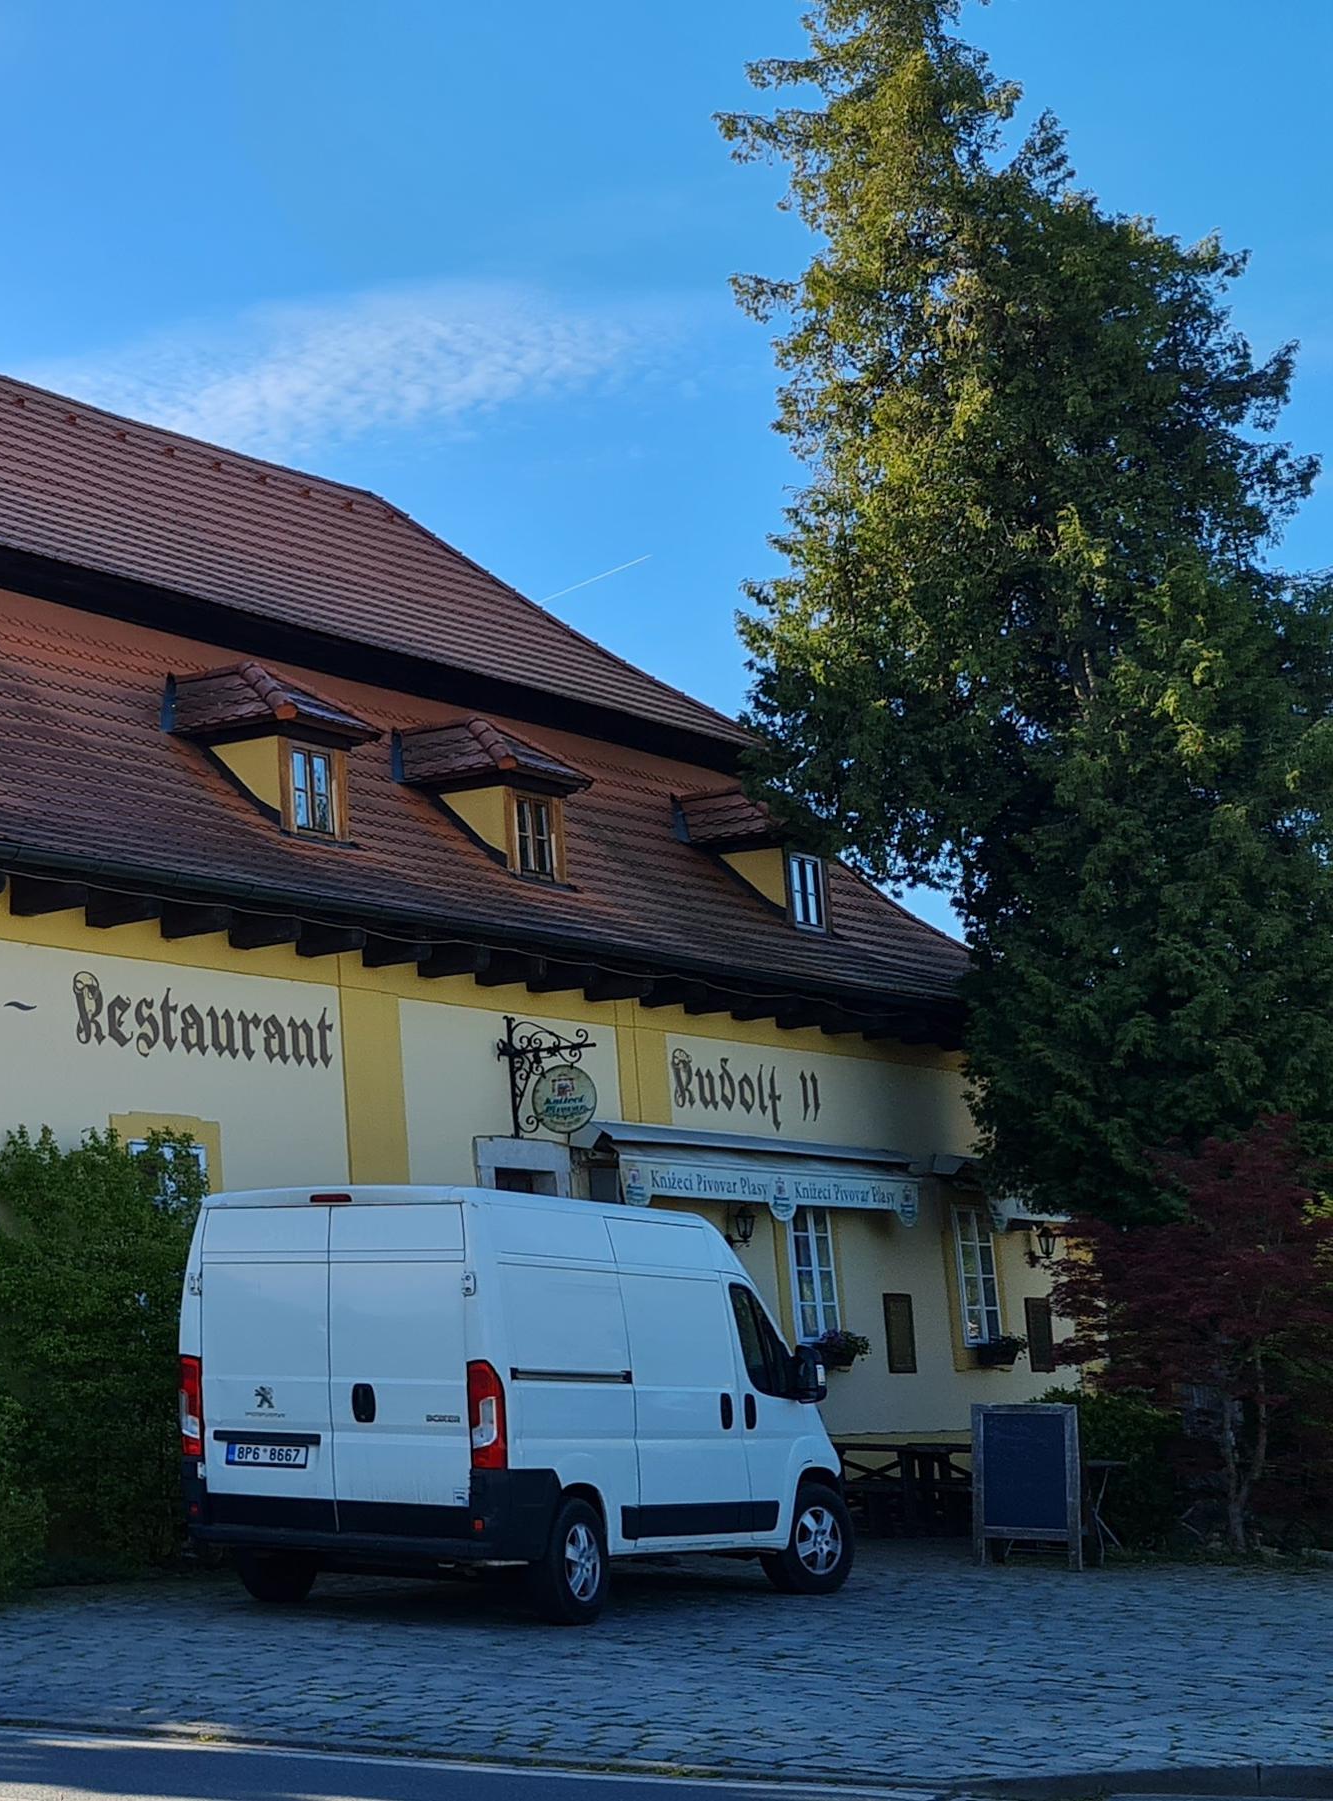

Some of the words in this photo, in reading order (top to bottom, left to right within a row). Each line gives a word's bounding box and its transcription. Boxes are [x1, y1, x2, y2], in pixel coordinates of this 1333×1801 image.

[72, 971, 334, 1070] Restaurant
[672, 1048, 782, 1132] Rudolf
[696, 1173, 737, 1193] Pivovar
[740, 1176, 767, 1201] Plasy
[237, 1446, 261, 1461] 8P6
[269, 1447, 301, 1463] 8667
